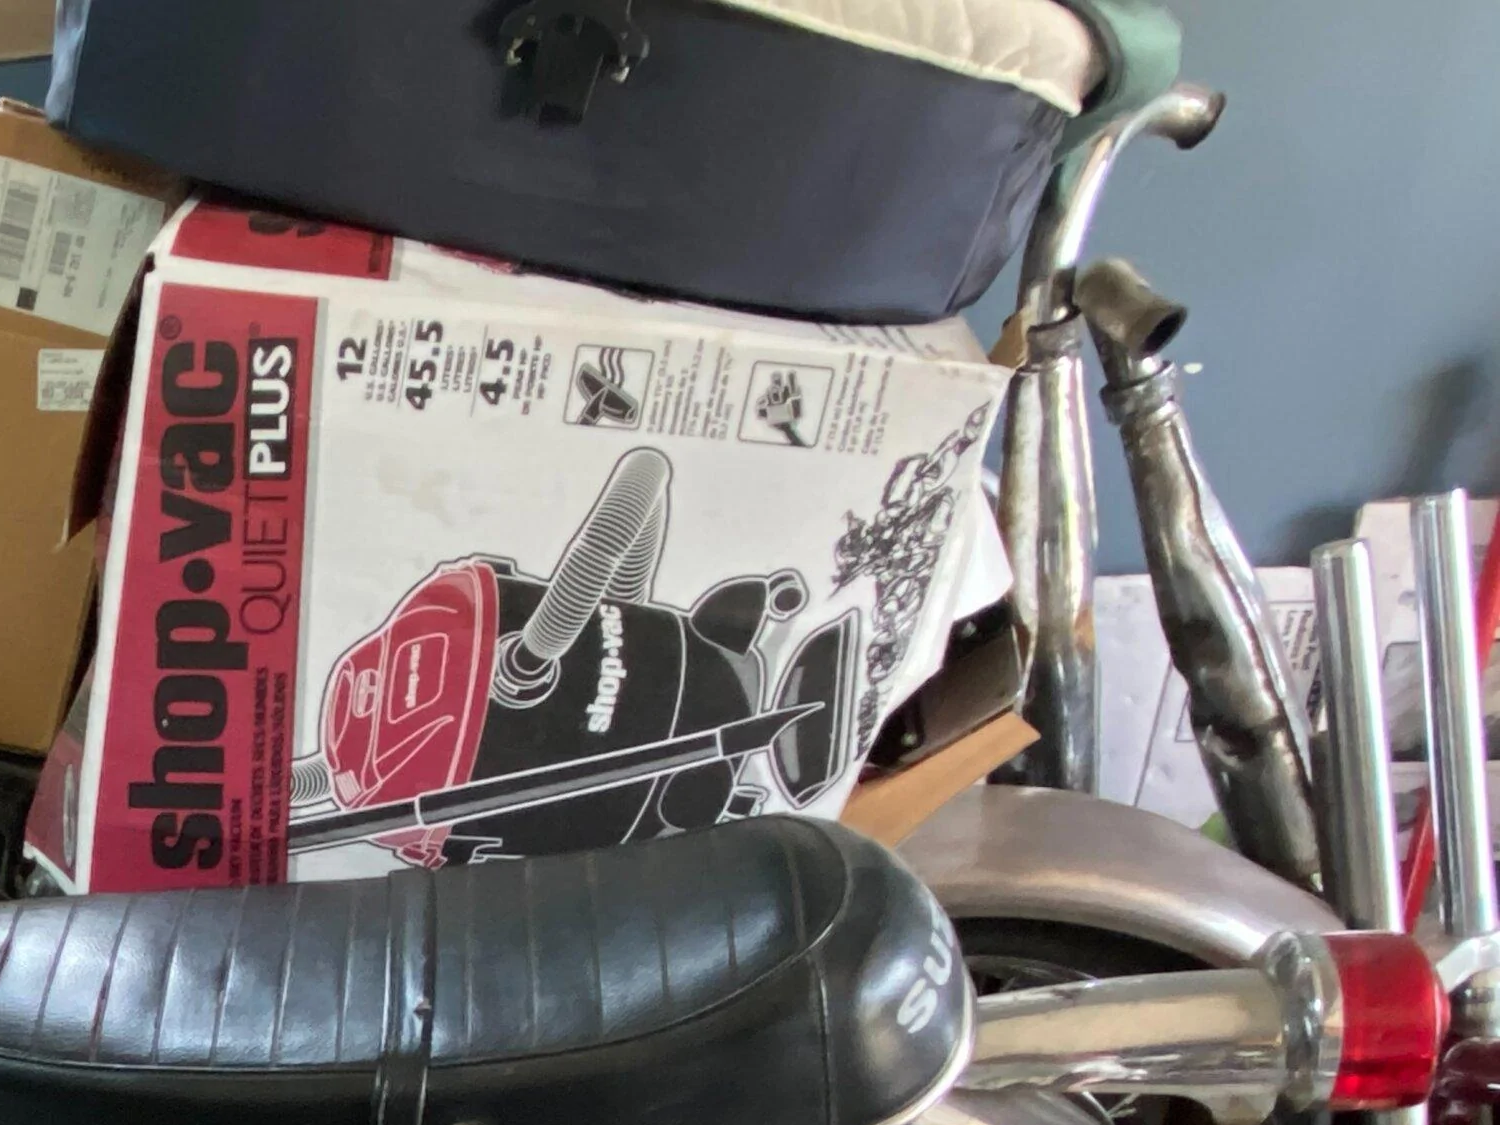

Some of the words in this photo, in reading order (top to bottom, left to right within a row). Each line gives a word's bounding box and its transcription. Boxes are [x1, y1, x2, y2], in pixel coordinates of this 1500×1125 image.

[336, 337, 367, 382] 12
[405, 319, 444, 410] 45.5
[479, 338, 514, 406] 4.5
[250, 343, 293, 477] PLUS
[239, 484, 288, 635] QUIET
